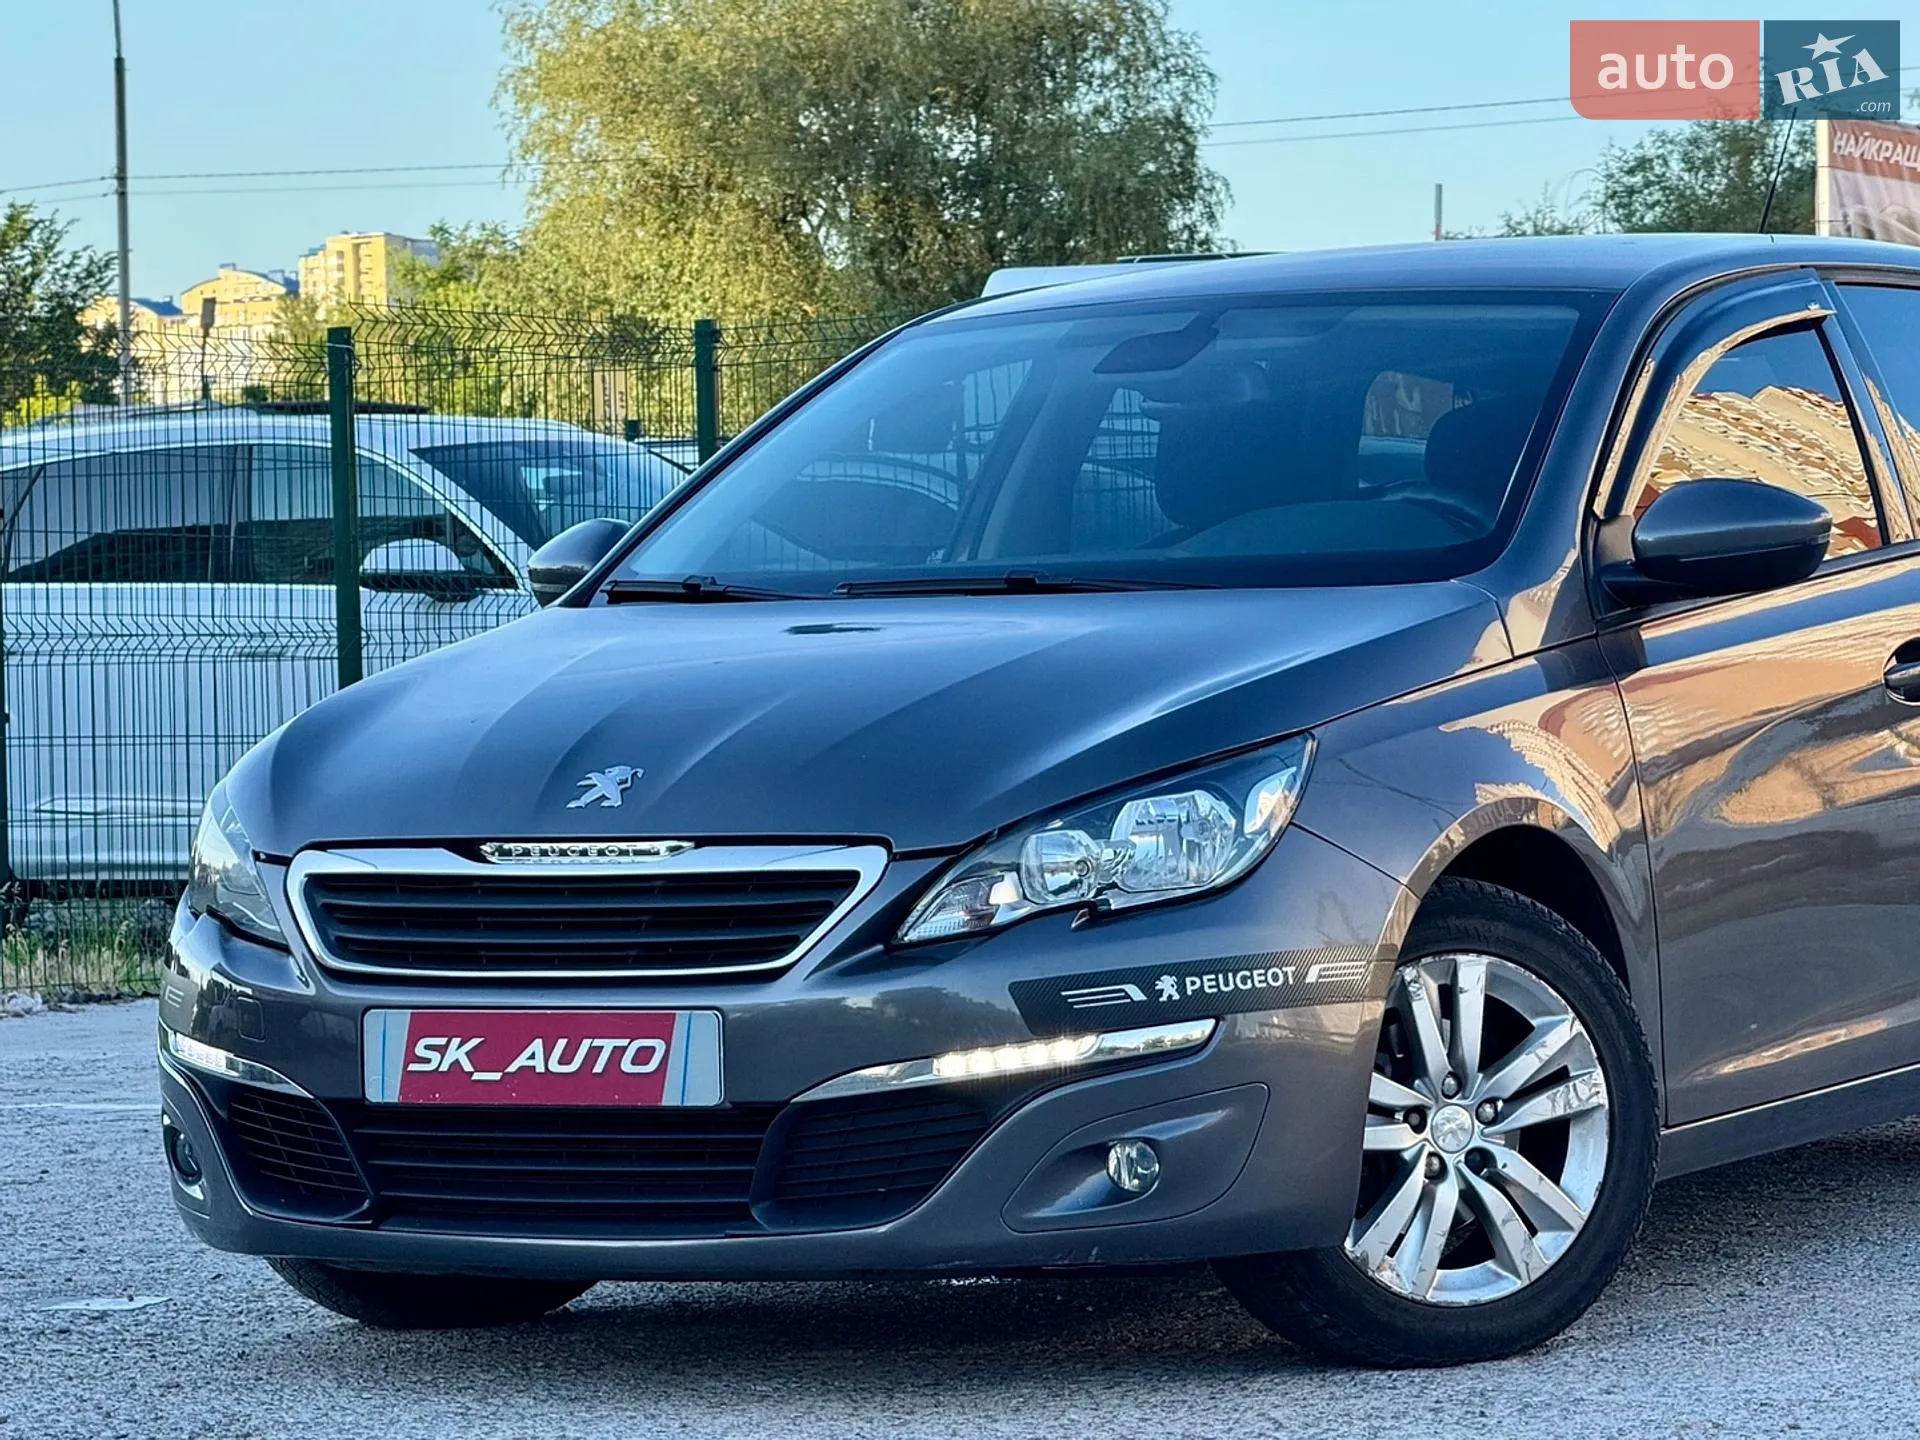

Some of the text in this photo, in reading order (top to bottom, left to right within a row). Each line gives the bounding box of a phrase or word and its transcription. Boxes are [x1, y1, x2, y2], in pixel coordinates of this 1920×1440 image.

[510, 844, 636, 857] PEUGEOT
[1185, 966, 1297, 995] PEUGEOT
[406, 1037, 667, 1081] SK_AUTO
